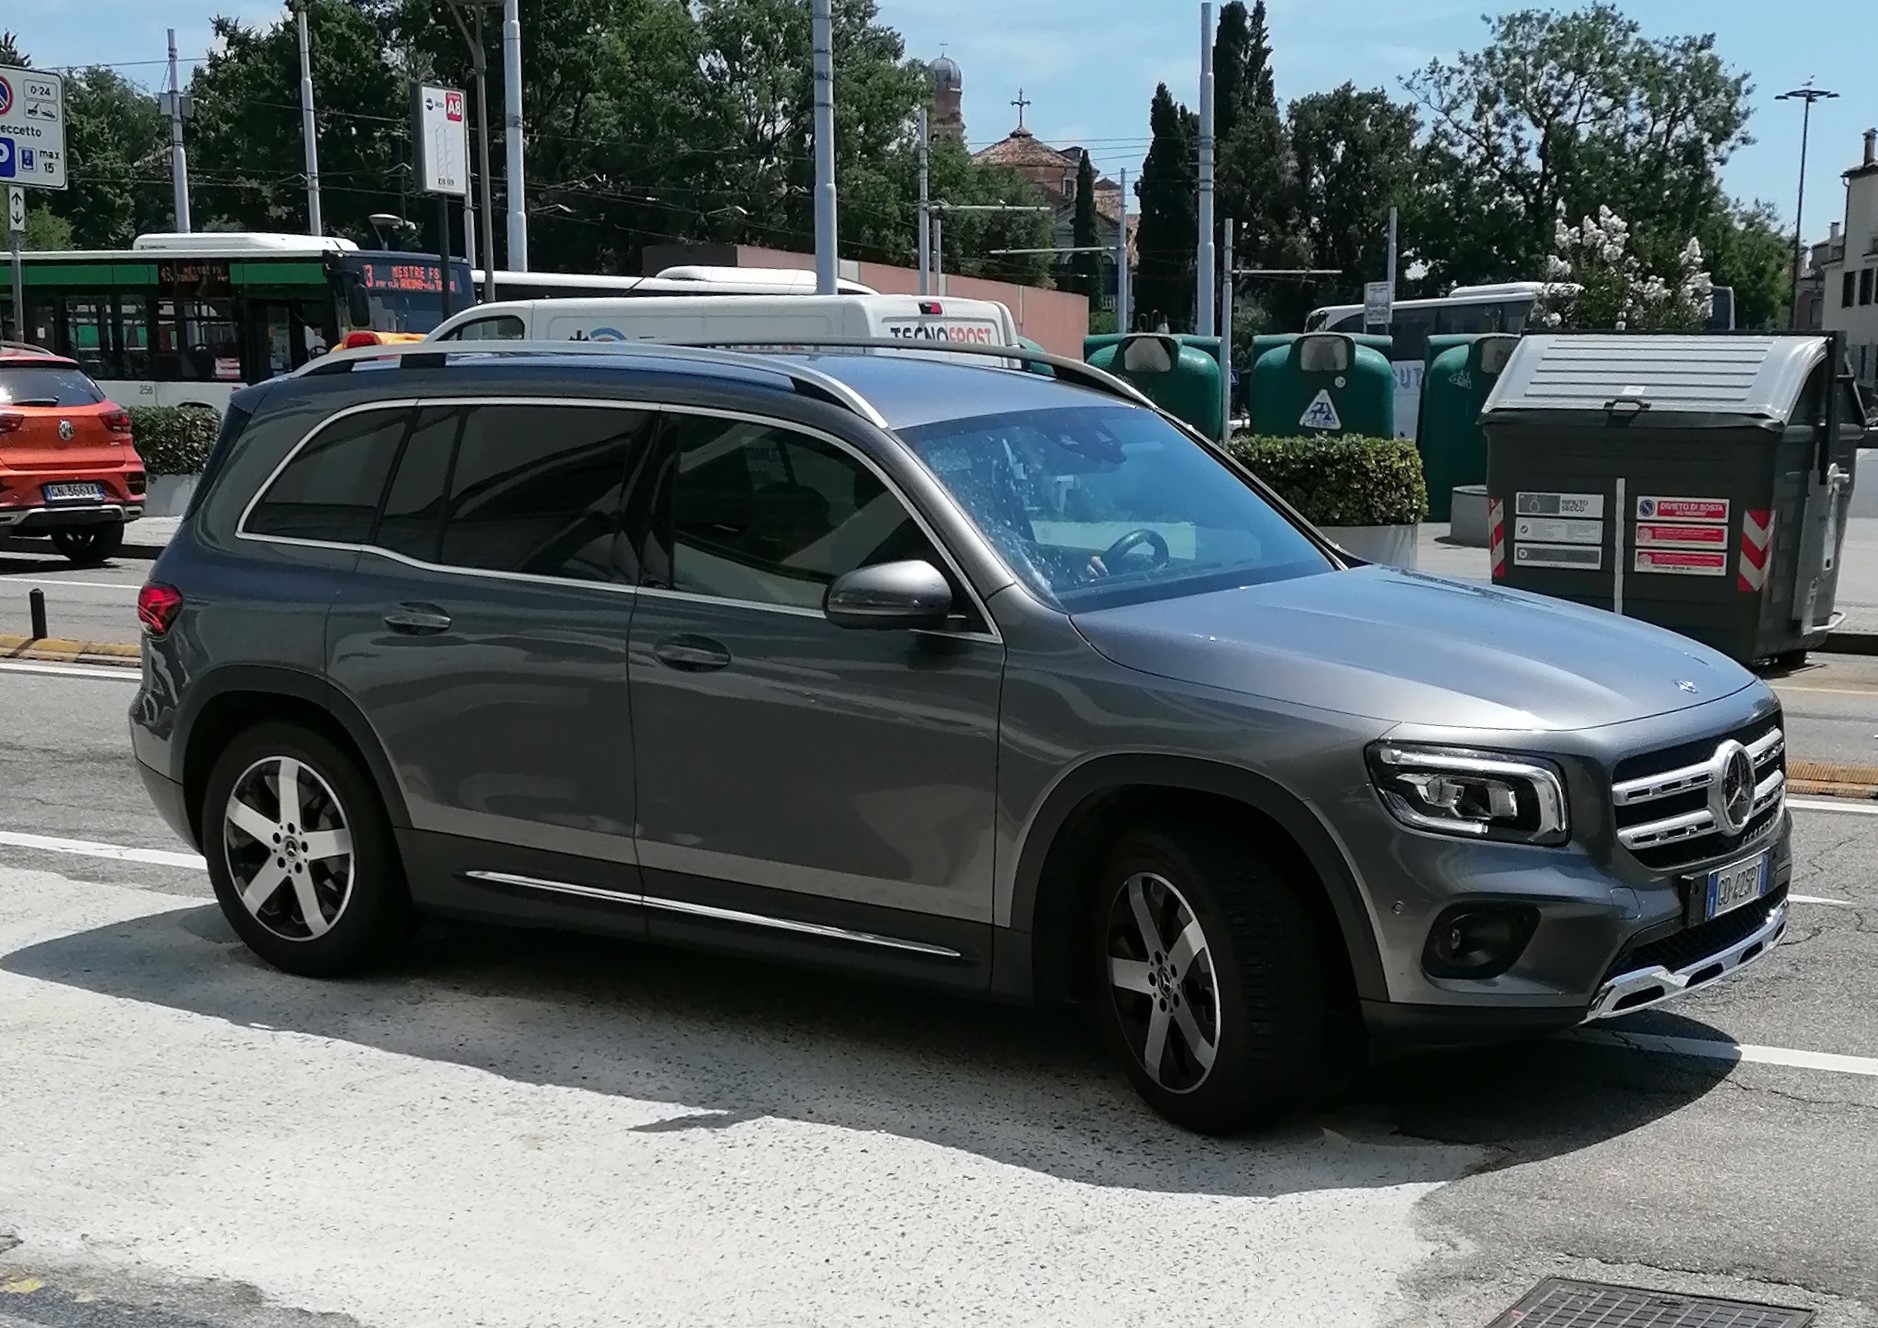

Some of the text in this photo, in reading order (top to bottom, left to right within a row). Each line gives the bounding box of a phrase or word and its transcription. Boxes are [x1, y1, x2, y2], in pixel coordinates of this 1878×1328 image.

[448, 99, 461, 117] A8
[0, 124, 42, 137] eccetto
[39, 150, 60, 160] max
[43, 162, 55, 174] 15
[1660, 502, 1725, 512] DIVIETO DI SOSTA
